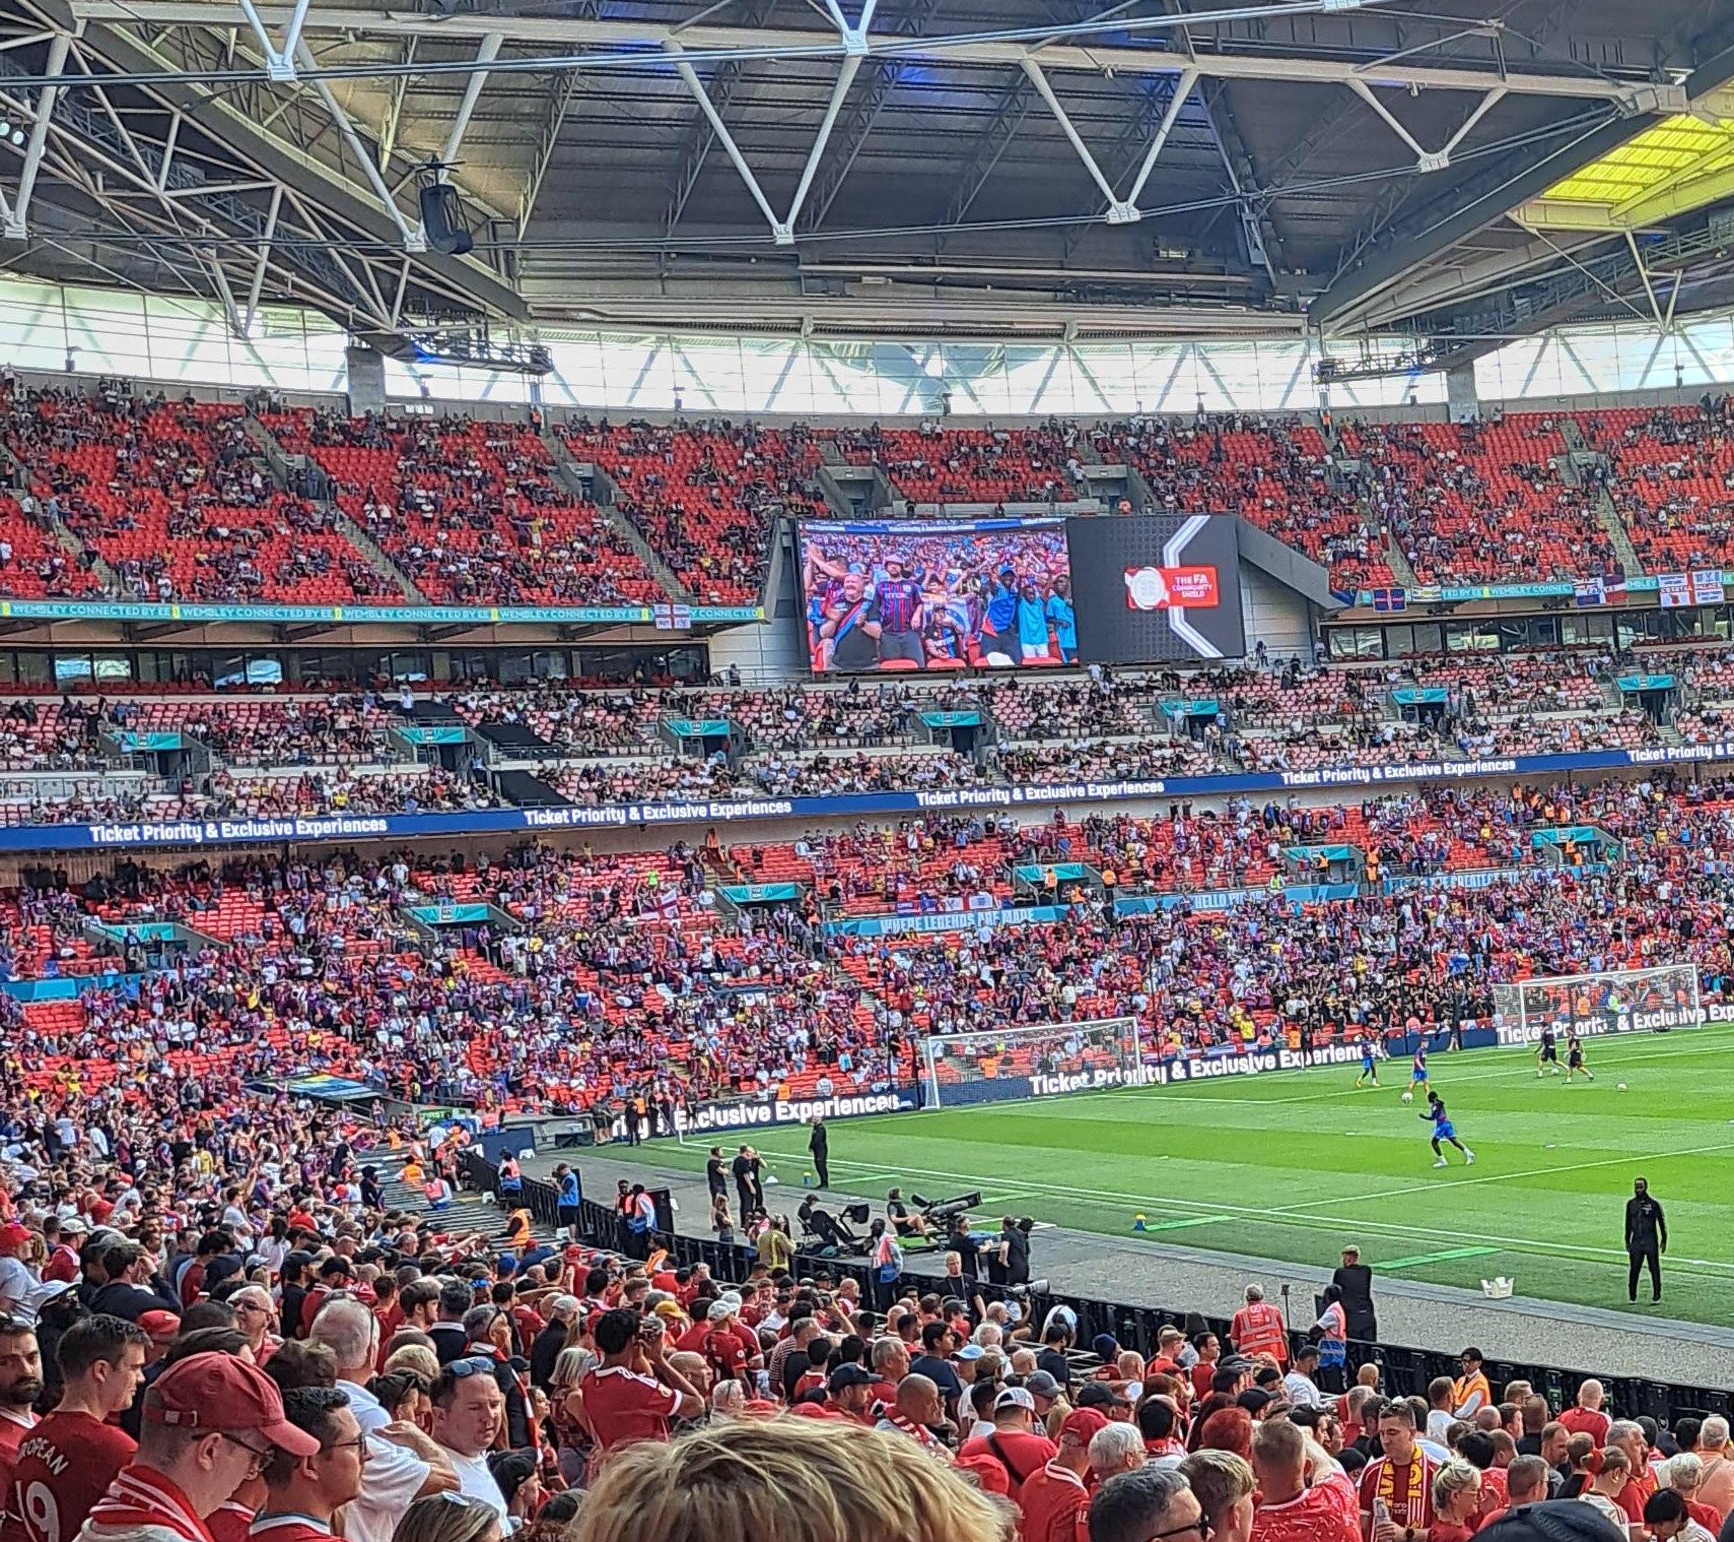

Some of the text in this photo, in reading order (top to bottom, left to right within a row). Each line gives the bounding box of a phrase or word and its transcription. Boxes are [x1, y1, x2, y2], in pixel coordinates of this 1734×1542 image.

[1193, 574, 1208, 584] FA
[1532, 584, 1574, 595] CONNECT
[13, 605, 170, 616] WEMBLEY CONNECTED BY EE
[183, 607, 333, 618] WEMBLEY CONNECTED BY EE
[343, 609, 489, 620] WEMBLEY CONNECTED BY EE
[500, 609, 640, 620] WEMBLEY CONNECTED BY EE
[699, 608, 757, 619] CONNECTED
[1627, 750, 1665, 763] Ticket
[1667, 745, 1713, 760] Priority
[1715, 744, 1725, 756] &
[1281, 759, 1516, 786] Ticket Priority & Exclusive Experiences
[916, 781, 1165, 806] Ticket Priority & Exclusive Experiences
[524, 800, 792, 826] Ticket Priority & Exclusive Experiences
[90, 817, 387, 843] Ticket Priority & Exclusive Experiences
[880, 917, 921, 934] WHERE
[925, 913, 975, 931] LEGENDS
[1617, 1014, 1631, 1031] &
[1029, 1070, 1089, 1095] Ticket
[1171, 1061, 1187, 1080] &
[1190, 1052, 1275, 1078] Exclusive
[775, 1094, 900, 1123] Experiences
